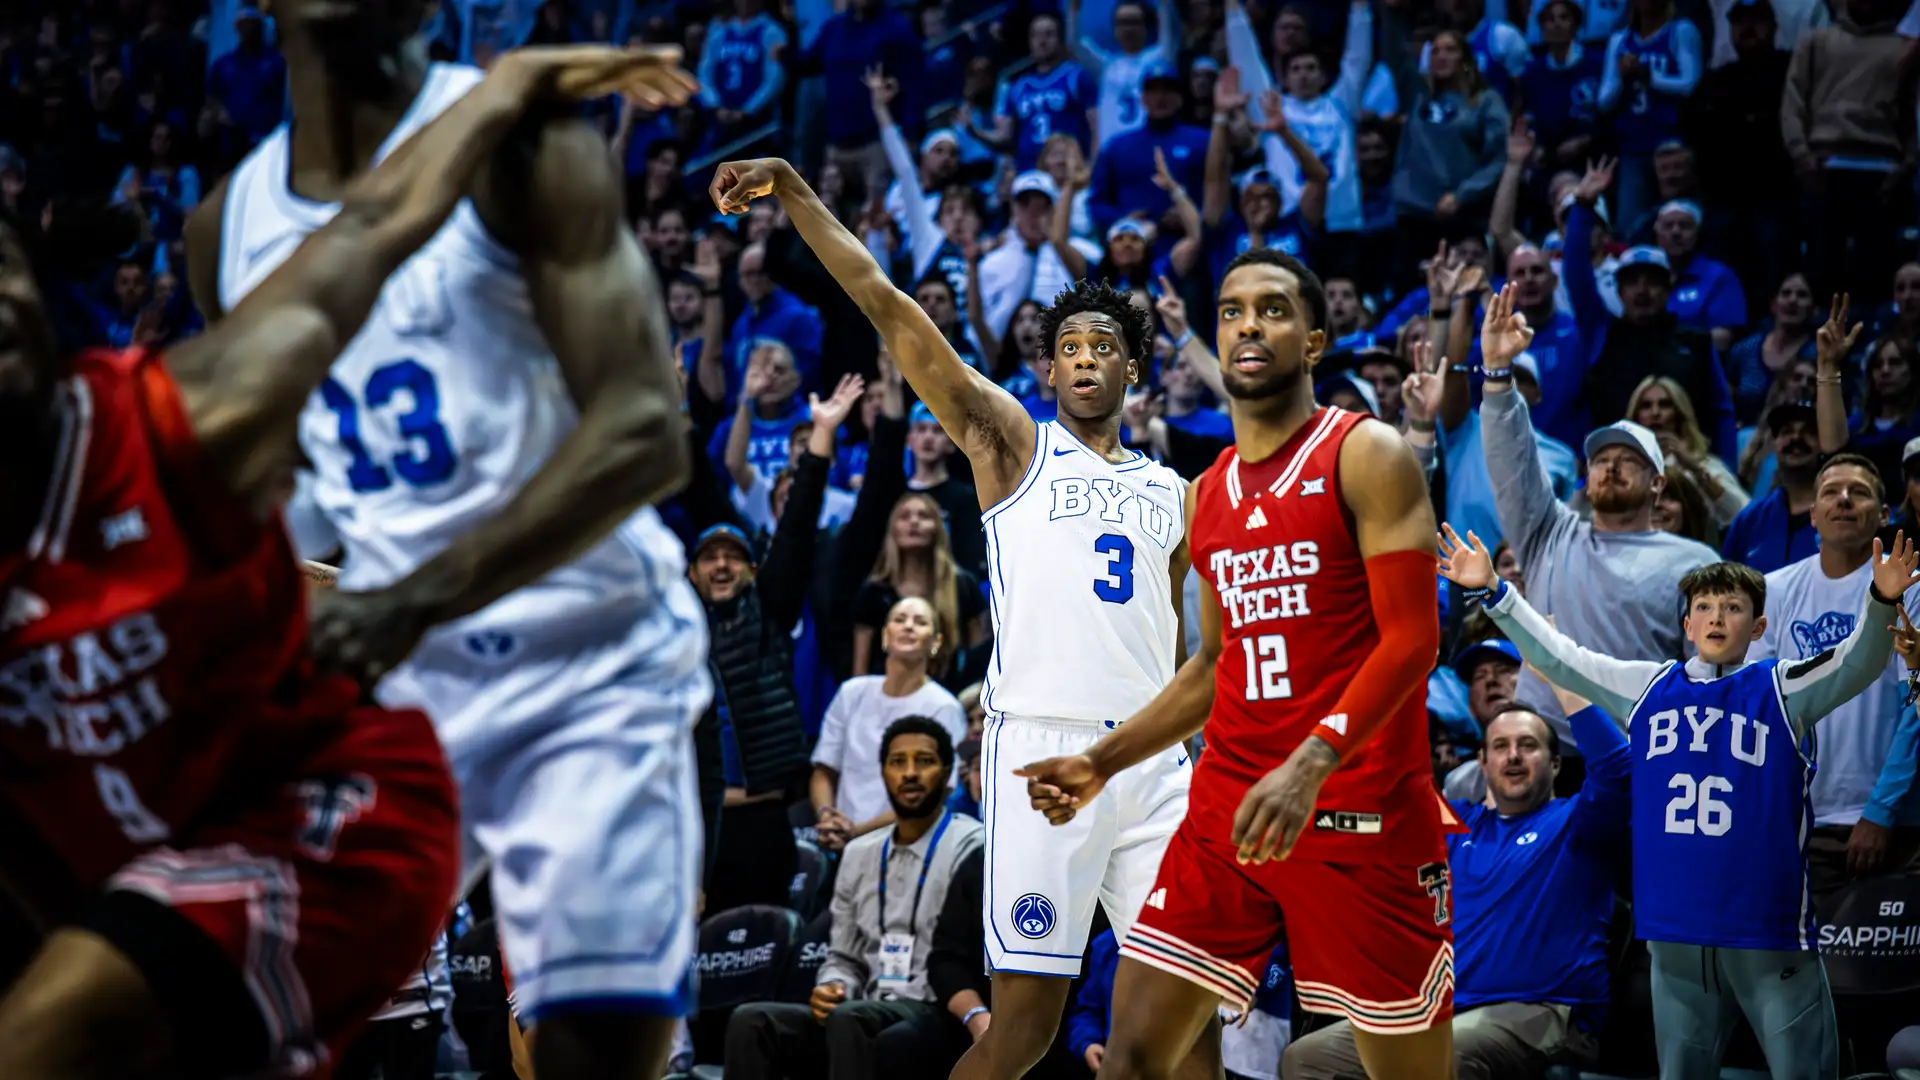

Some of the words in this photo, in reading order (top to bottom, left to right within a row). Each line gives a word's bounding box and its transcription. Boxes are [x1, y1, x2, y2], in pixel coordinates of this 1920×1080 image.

[321, 360, 456, 492] 13
[1049, 477, 1172, 549] BYU
[1093, 533, 1135, 605] 3
[1210, 540, 1320, 592] TEXAS
[1220, 582, 1311, 629] TECH
[1817, 623, 1849, 643] BYU
[1241, 633, 1292, 701] 12
[1646, 705, 1770, 767] BYU
[1664, 772, 1733, 837] 26
[1878, 901, 1905, 916] 50
[1817, 924, 1920, 948] SAPPHI
[1871, 948, 1920, 957] MANAGE
[450, 954, 491, 974] SAP
